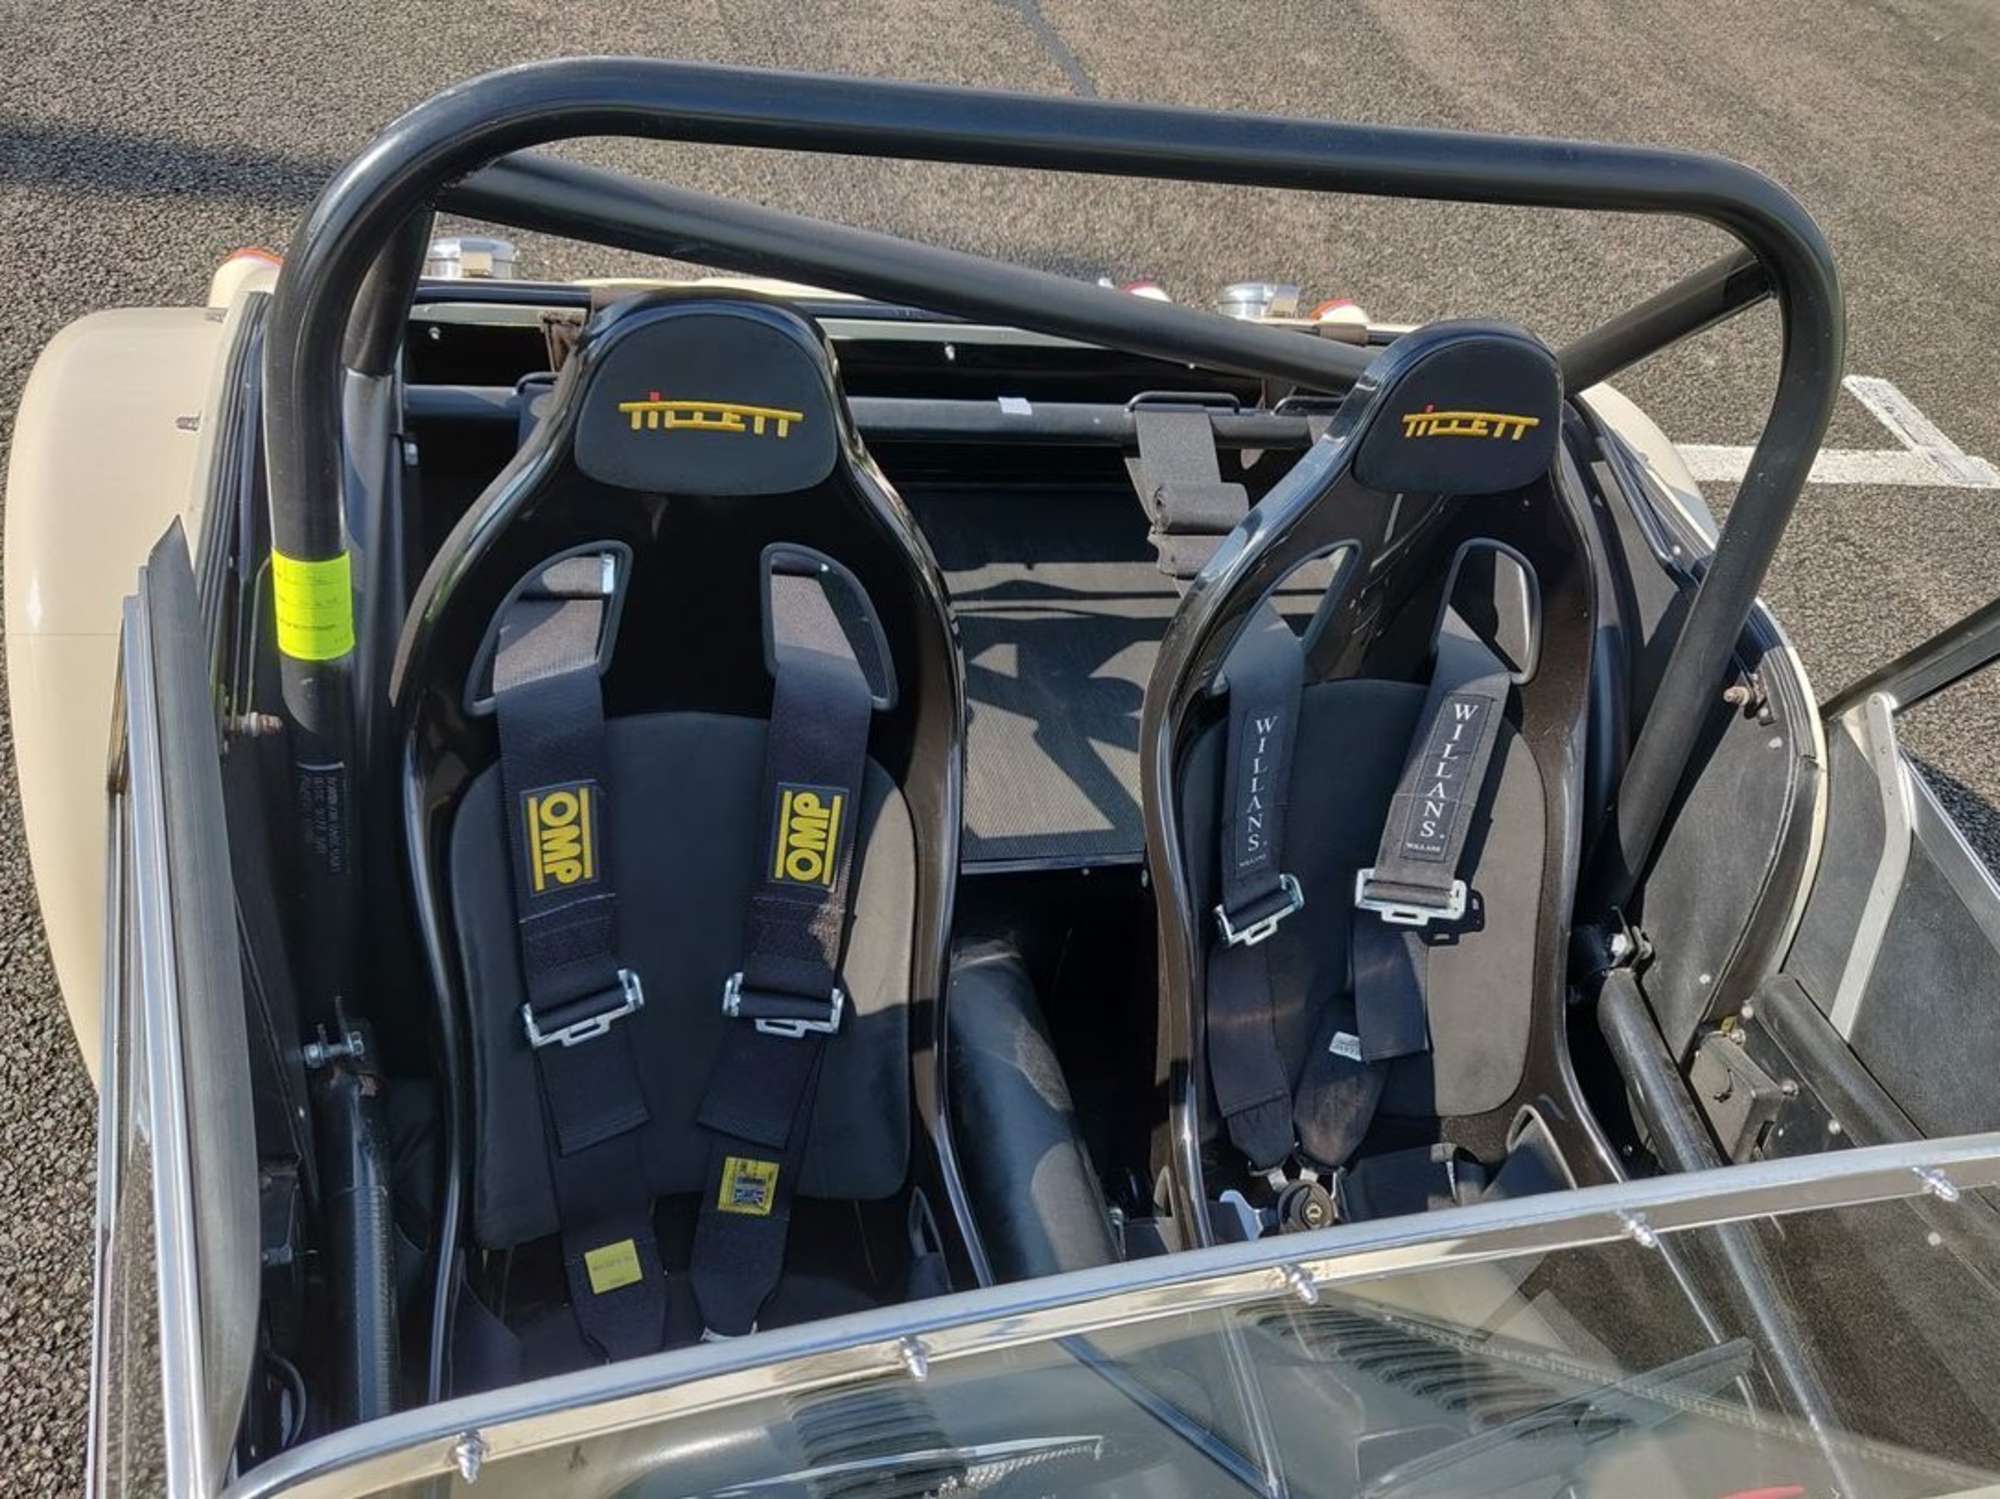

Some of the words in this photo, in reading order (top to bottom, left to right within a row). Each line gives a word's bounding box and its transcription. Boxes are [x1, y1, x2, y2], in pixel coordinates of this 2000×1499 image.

[1403, 404, 1539, 440] TILLETT
[540, 790, 583, 884] OMP
[785, 792, 831, 881] OMP
